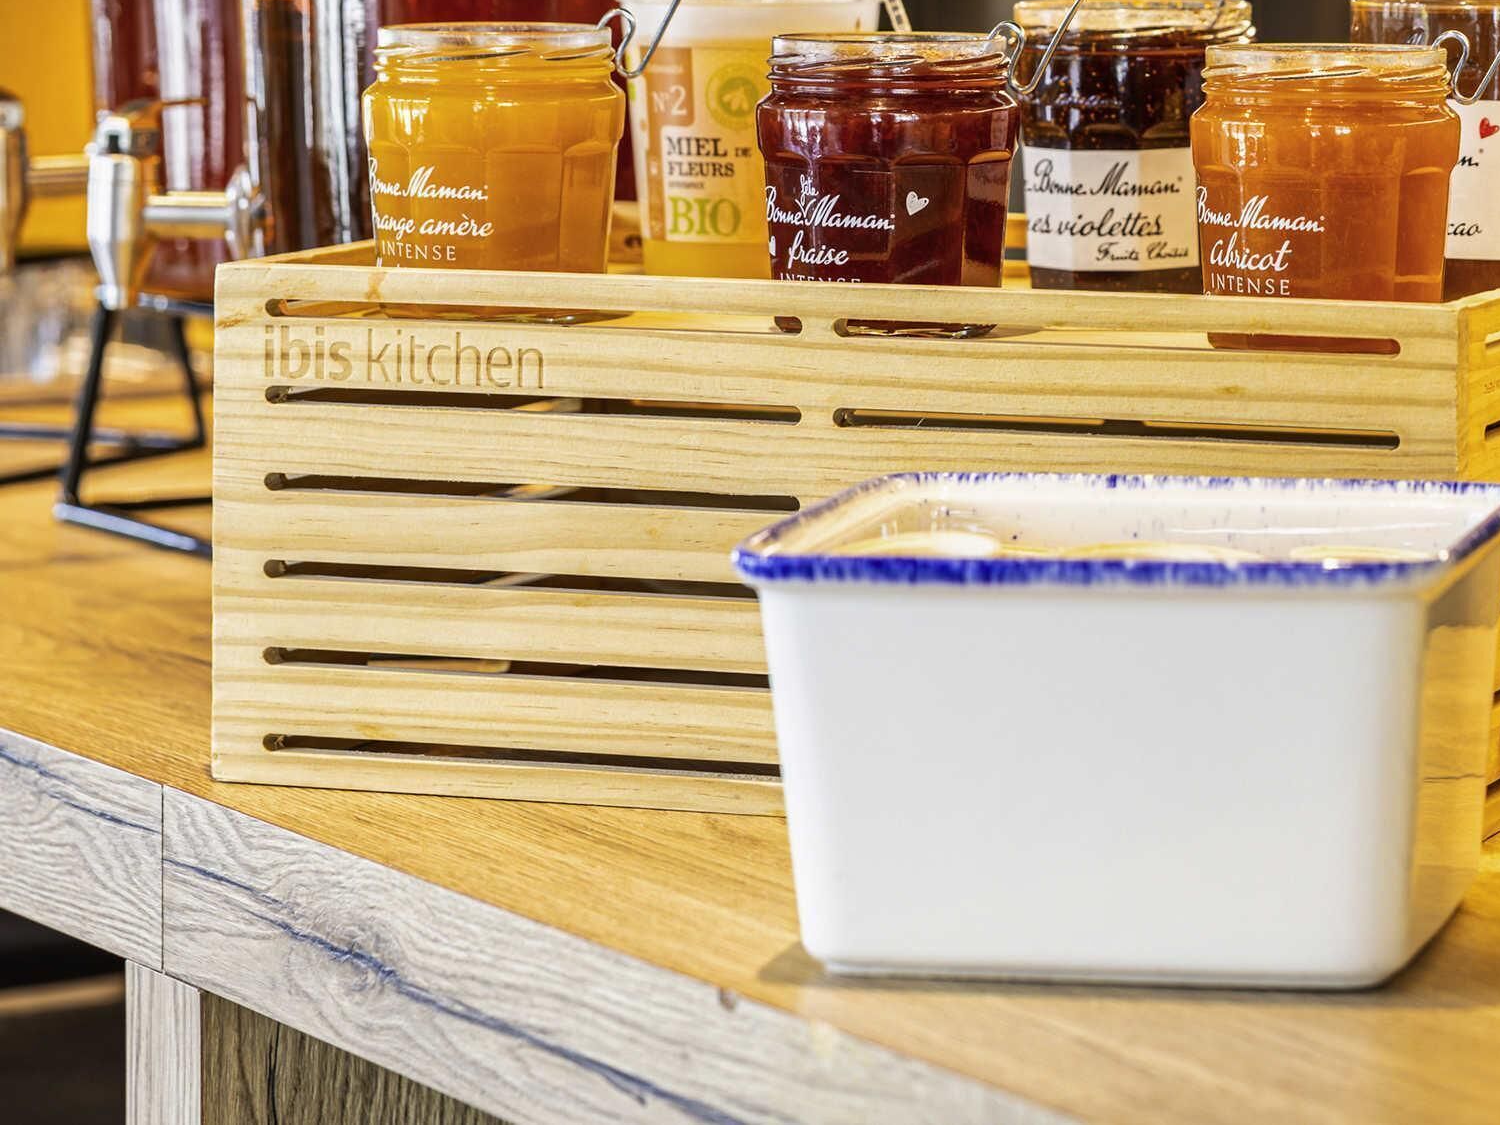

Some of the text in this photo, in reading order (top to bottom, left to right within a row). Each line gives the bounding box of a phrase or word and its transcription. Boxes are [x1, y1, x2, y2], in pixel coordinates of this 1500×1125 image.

[666, 136, 728, 158] MIEL
[402, 165, 489, 201] Maman
[667, 162, 735, 178] FLEURS
[1032, 158, 1184, 197] Bonne Maman
[371, 204, 495, 241] range amère
[668, 196, 741, 238] BIO
[764, 185, 896, 231] Bonne Maman
[1057, 208, 1164, 237] violettes
[1196, 185, 1326, 233] Bonne Maman
[381, 240, 457, 261] INTENSE
[1210, 272, 1291, 296] INTENSE
[263, 325, 545, 389] ibis kitchen
